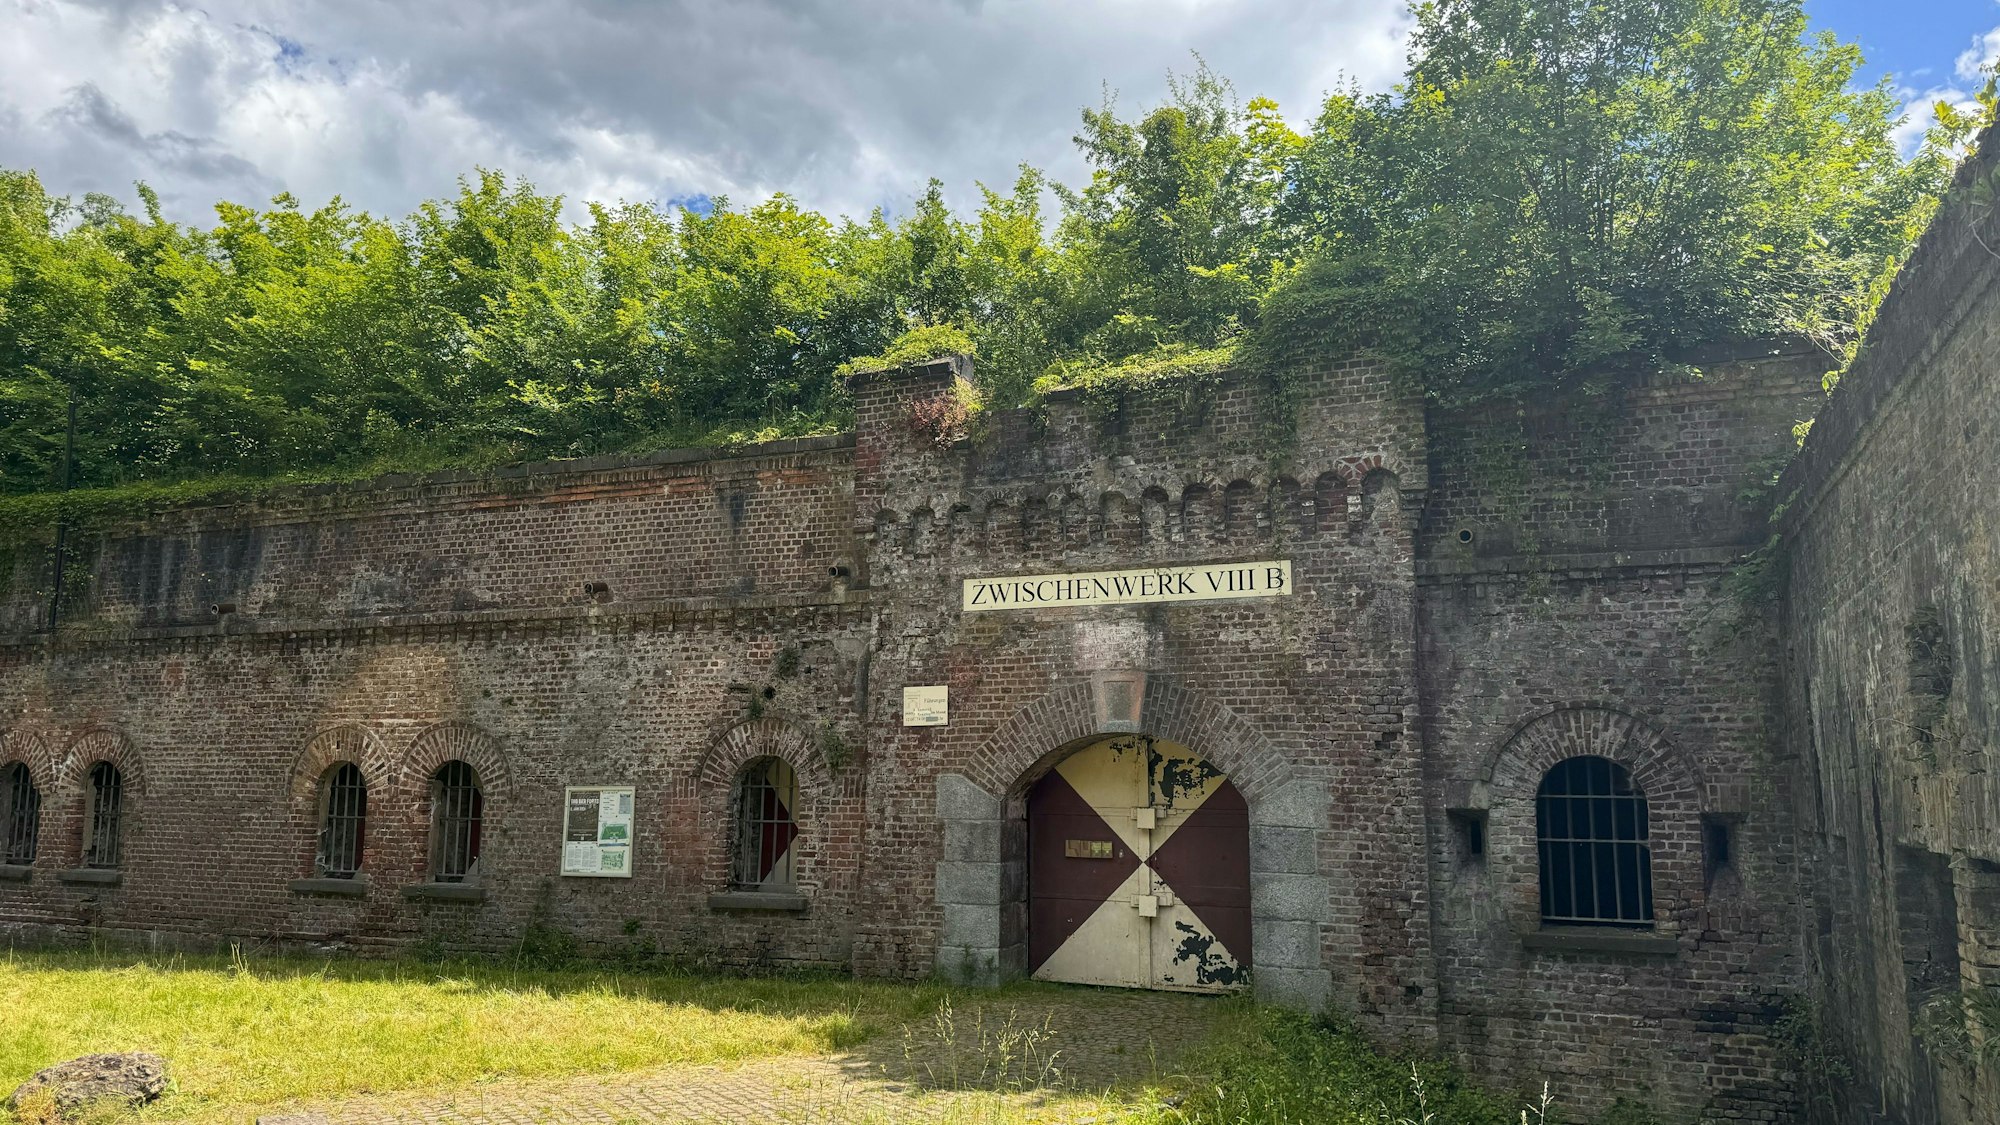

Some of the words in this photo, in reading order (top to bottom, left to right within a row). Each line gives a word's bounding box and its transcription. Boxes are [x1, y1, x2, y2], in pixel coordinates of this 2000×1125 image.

[971, 572, 1198, 604] ZWISCHENWERK
[1205, 568, 1256, 592] VIII
[1265, 567, 1285, 590] B
